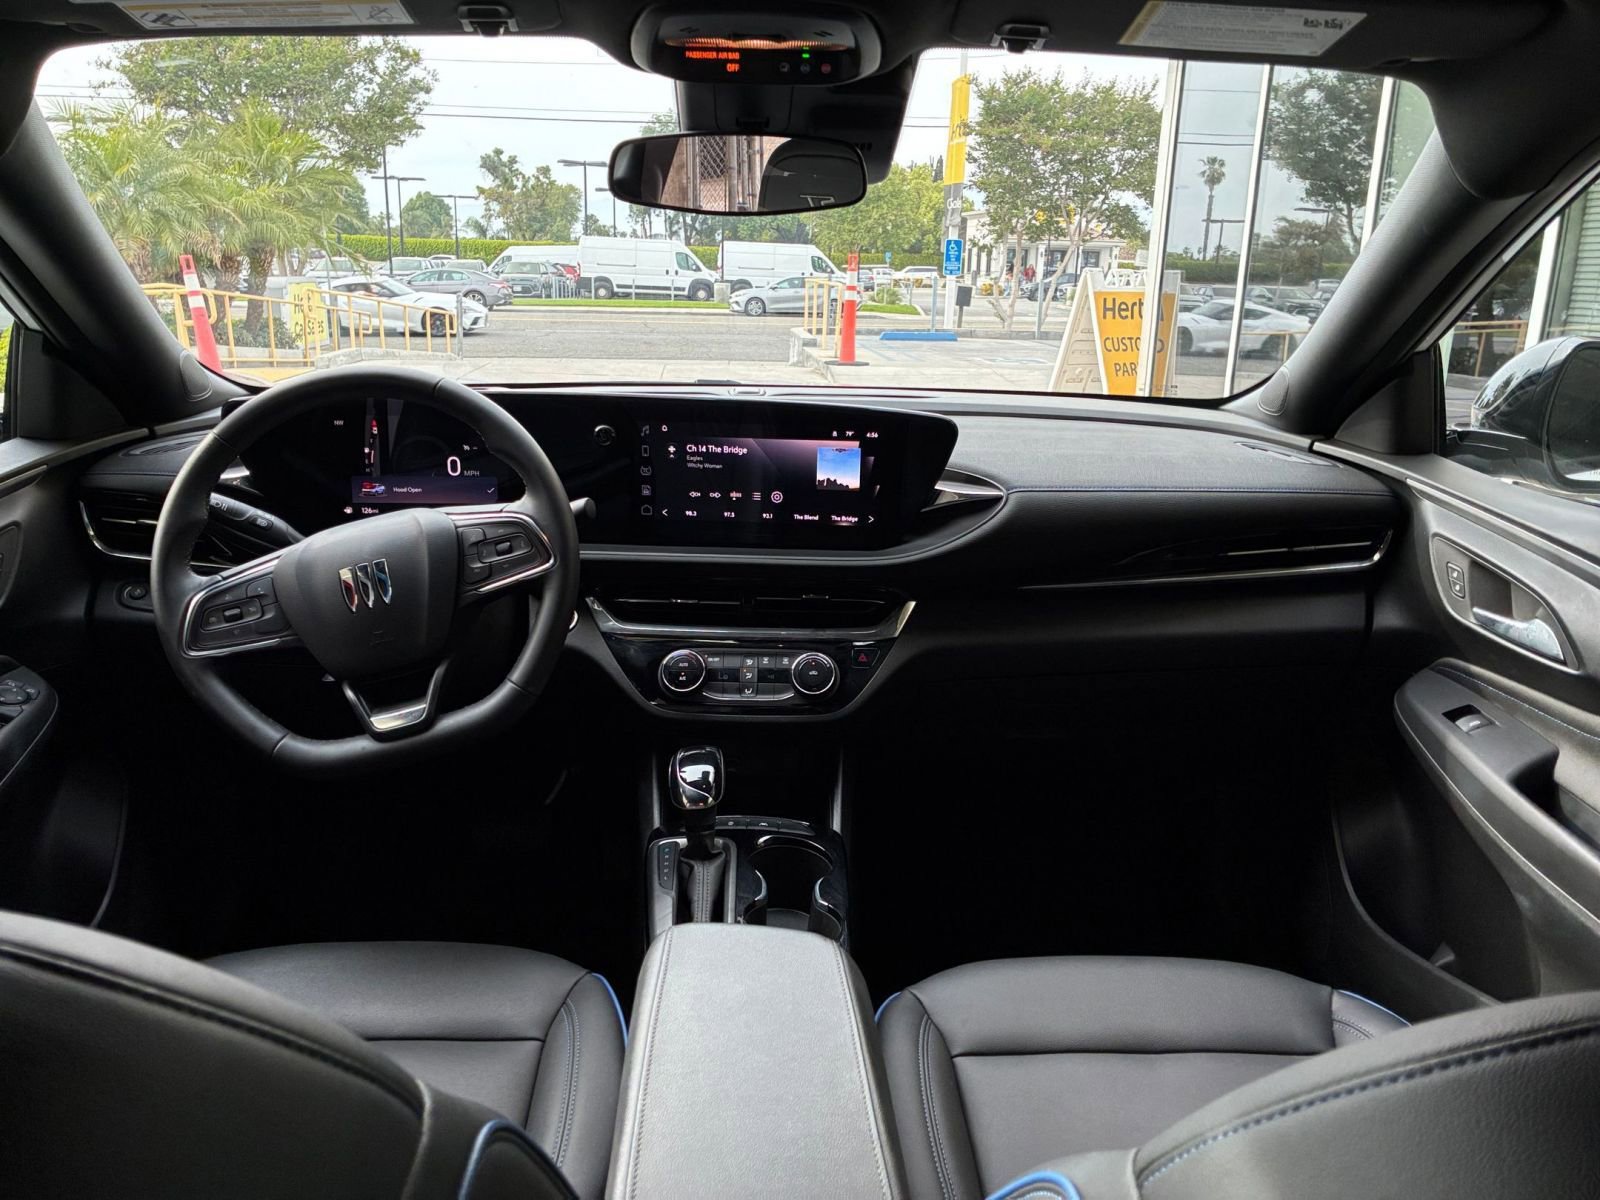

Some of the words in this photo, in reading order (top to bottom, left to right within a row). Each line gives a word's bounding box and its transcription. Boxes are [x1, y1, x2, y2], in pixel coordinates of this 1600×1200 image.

[685, 51, 717, 59] PASSENGER
[727, 64, 740, 72] OFF
[1102, 297, 1144, 320] Hert
[1103, 336, 1141, 352] CUSTO
[1113, 362, 1138, 377] PAR
[686, 444, 697, 453] Ch
[698, 444, 707, 453] 14
[708, 445, 722, 453] The
[723, 446, 748, 455] Bridge
[446, 456, 461, 476] 0
[841, 515, 859, 523] Bridge
